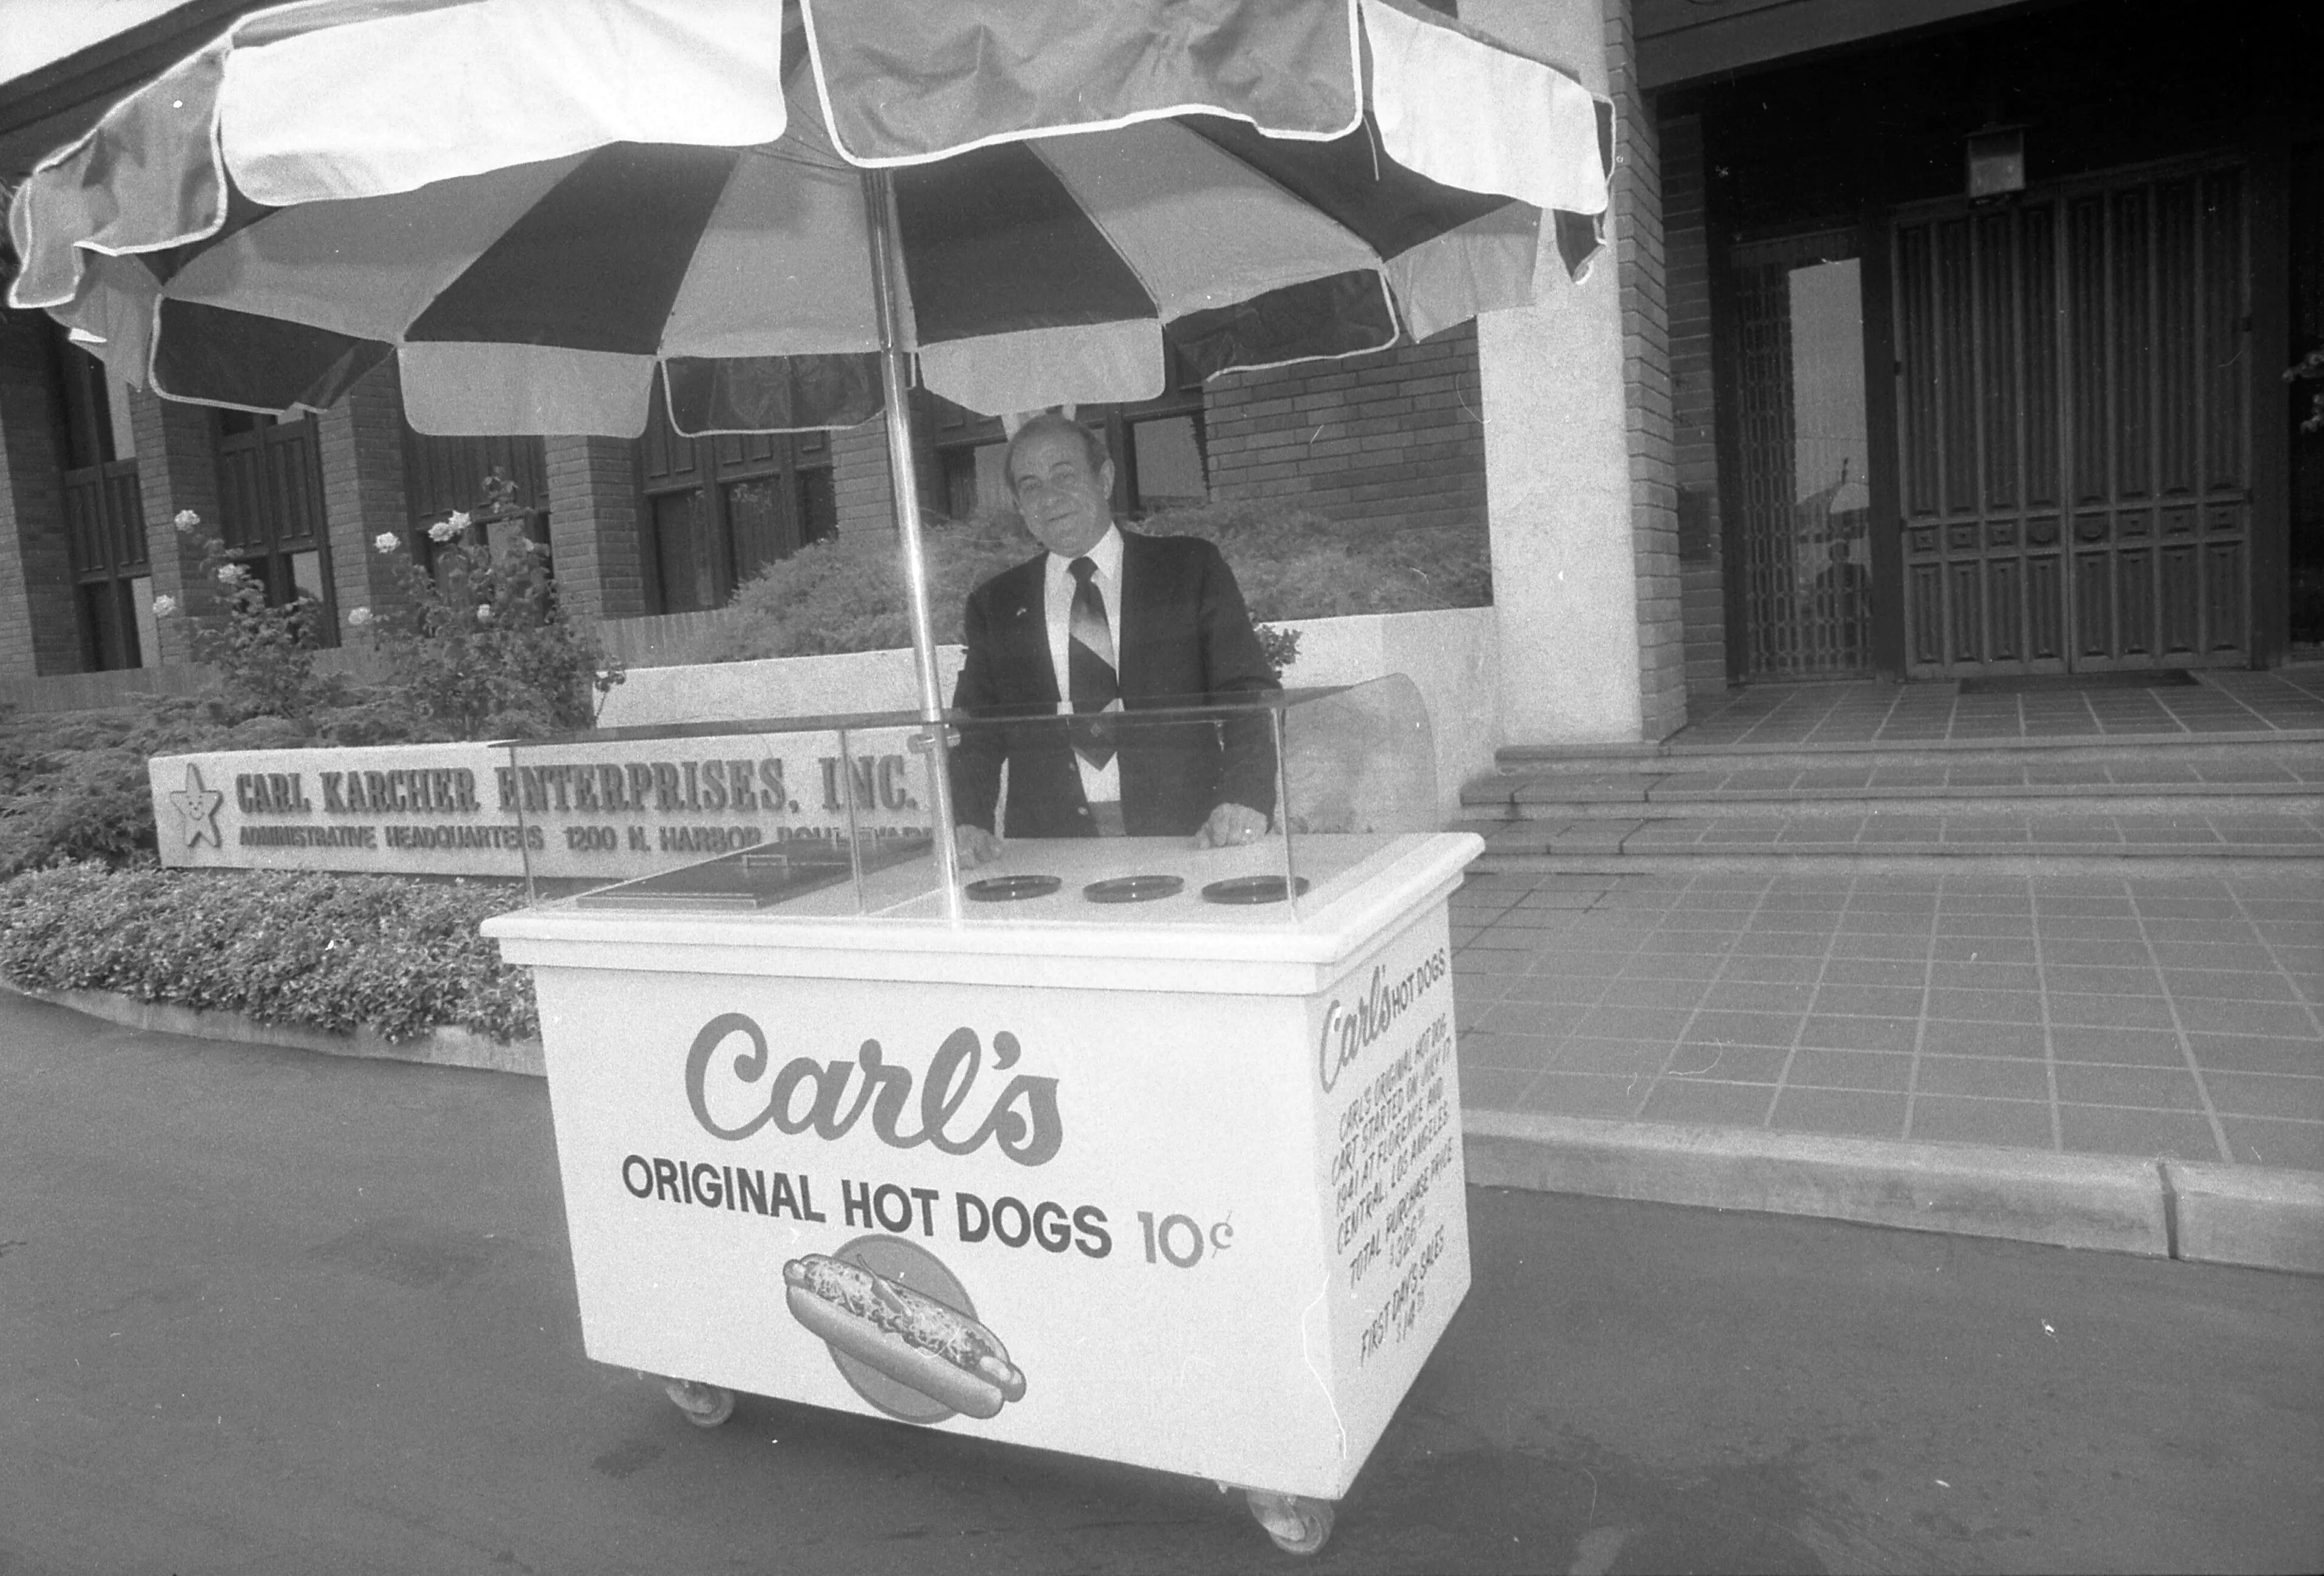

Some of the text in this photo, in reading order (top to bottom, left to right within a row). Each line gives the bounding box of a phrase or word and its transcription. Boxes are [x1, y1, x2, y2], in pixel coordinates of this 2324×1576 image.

[237, 756, 919, 813] CARL KARCHER ENTERPRISES, INC.
[240, 826, 377, 849] ADMINISTRATIVE
[384, 825, 544, 849] HEADQUARTERS
[563, 826, 617, 852] 1200
[628, 826, 652, 852] N.
[659, 826, 761, 853] HARBOR
[1320, 947, 1445, 1093] Carl's HOT DOGS
[684, 1012, 1063, 1167] Carl's
[1331, 1134, 1359, 1187] CART
[622, 1154, 1234, 1269] ORIGINAL HOT DOGS 10¢
[1349, 1228, 1380, 1289] TOTAL
[1360, 1300, 1390, 1368] FIRST
[1421, 1223, 1444, 1280] SALES
